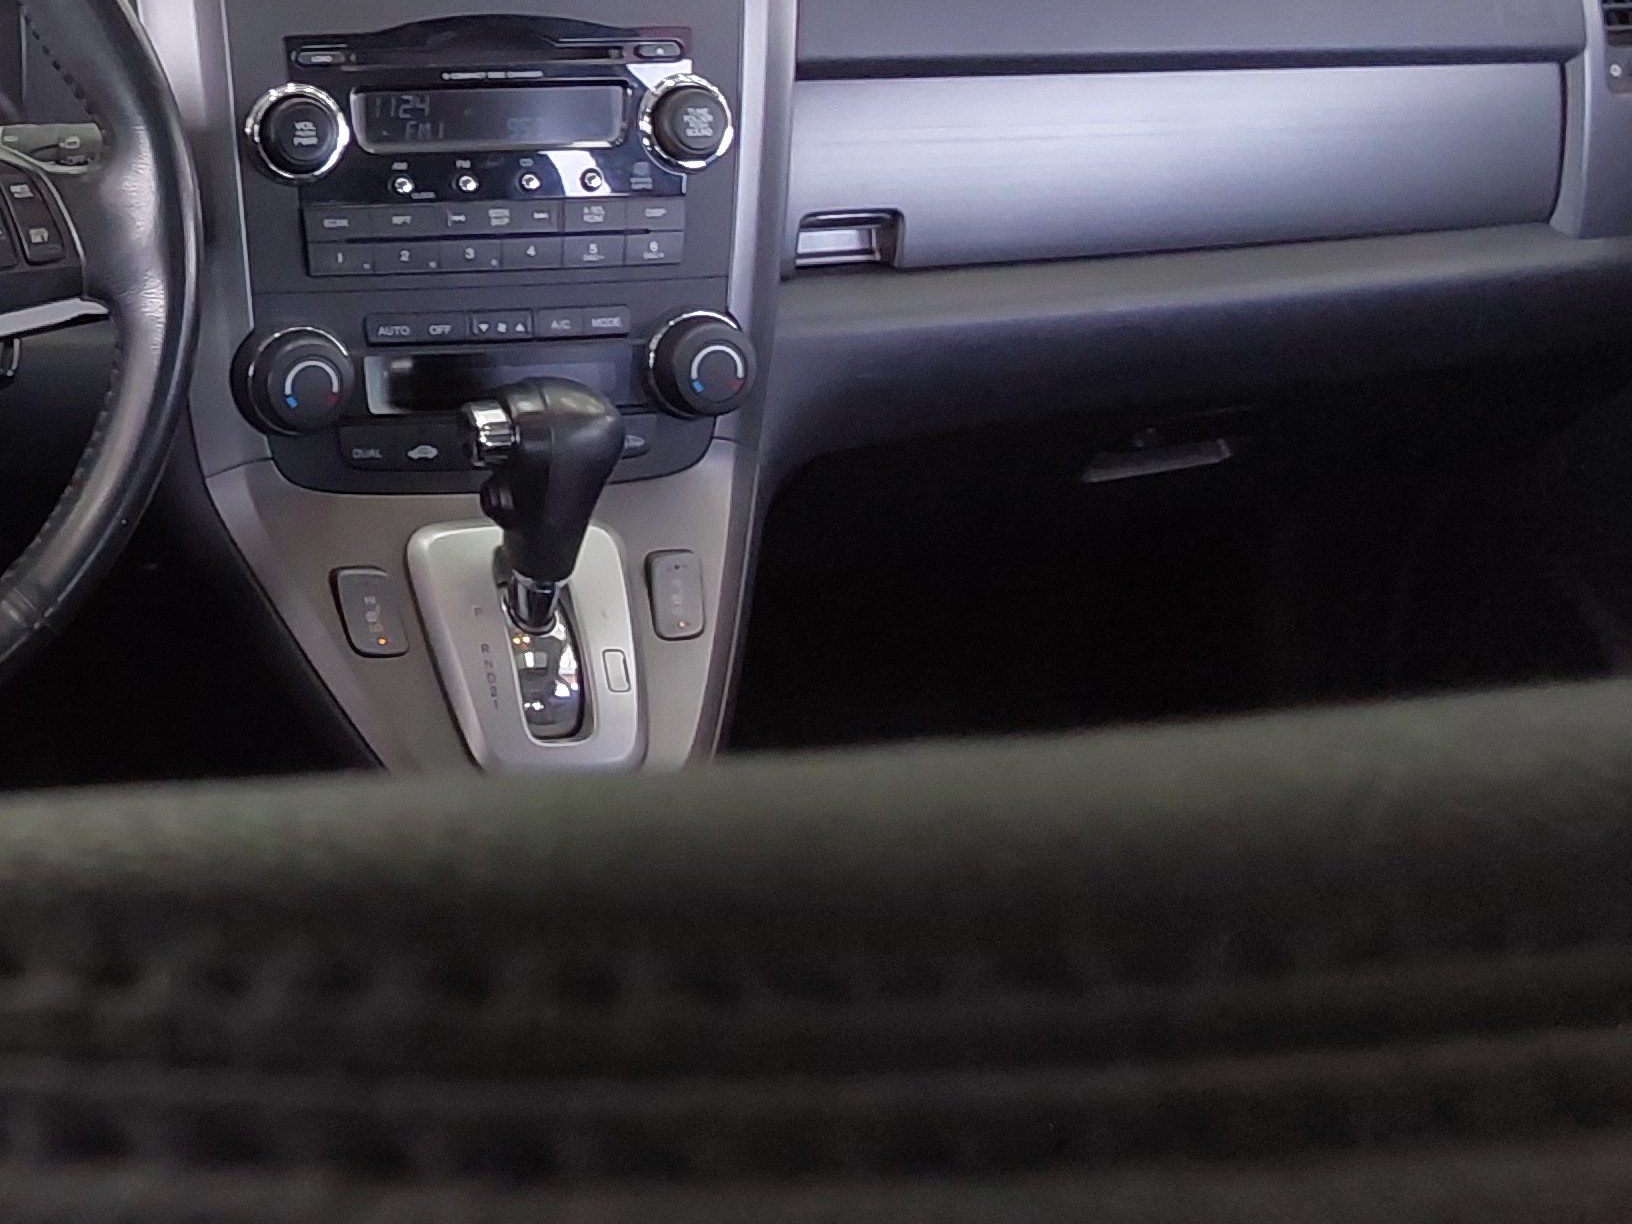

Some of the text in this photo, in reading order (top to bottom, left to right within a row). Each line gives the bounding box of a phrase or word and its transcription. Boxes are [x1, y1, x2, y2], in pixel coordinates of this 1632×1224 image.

[465, 248, 475, 259] 3
[527, 246, 537, 256] 4
[589, 244, 598, 254] 5
[400, 250, 410, 261] 2
[591, 317, 622, 328] MODE
[378, 324, 452, 336] AUTO OFF
